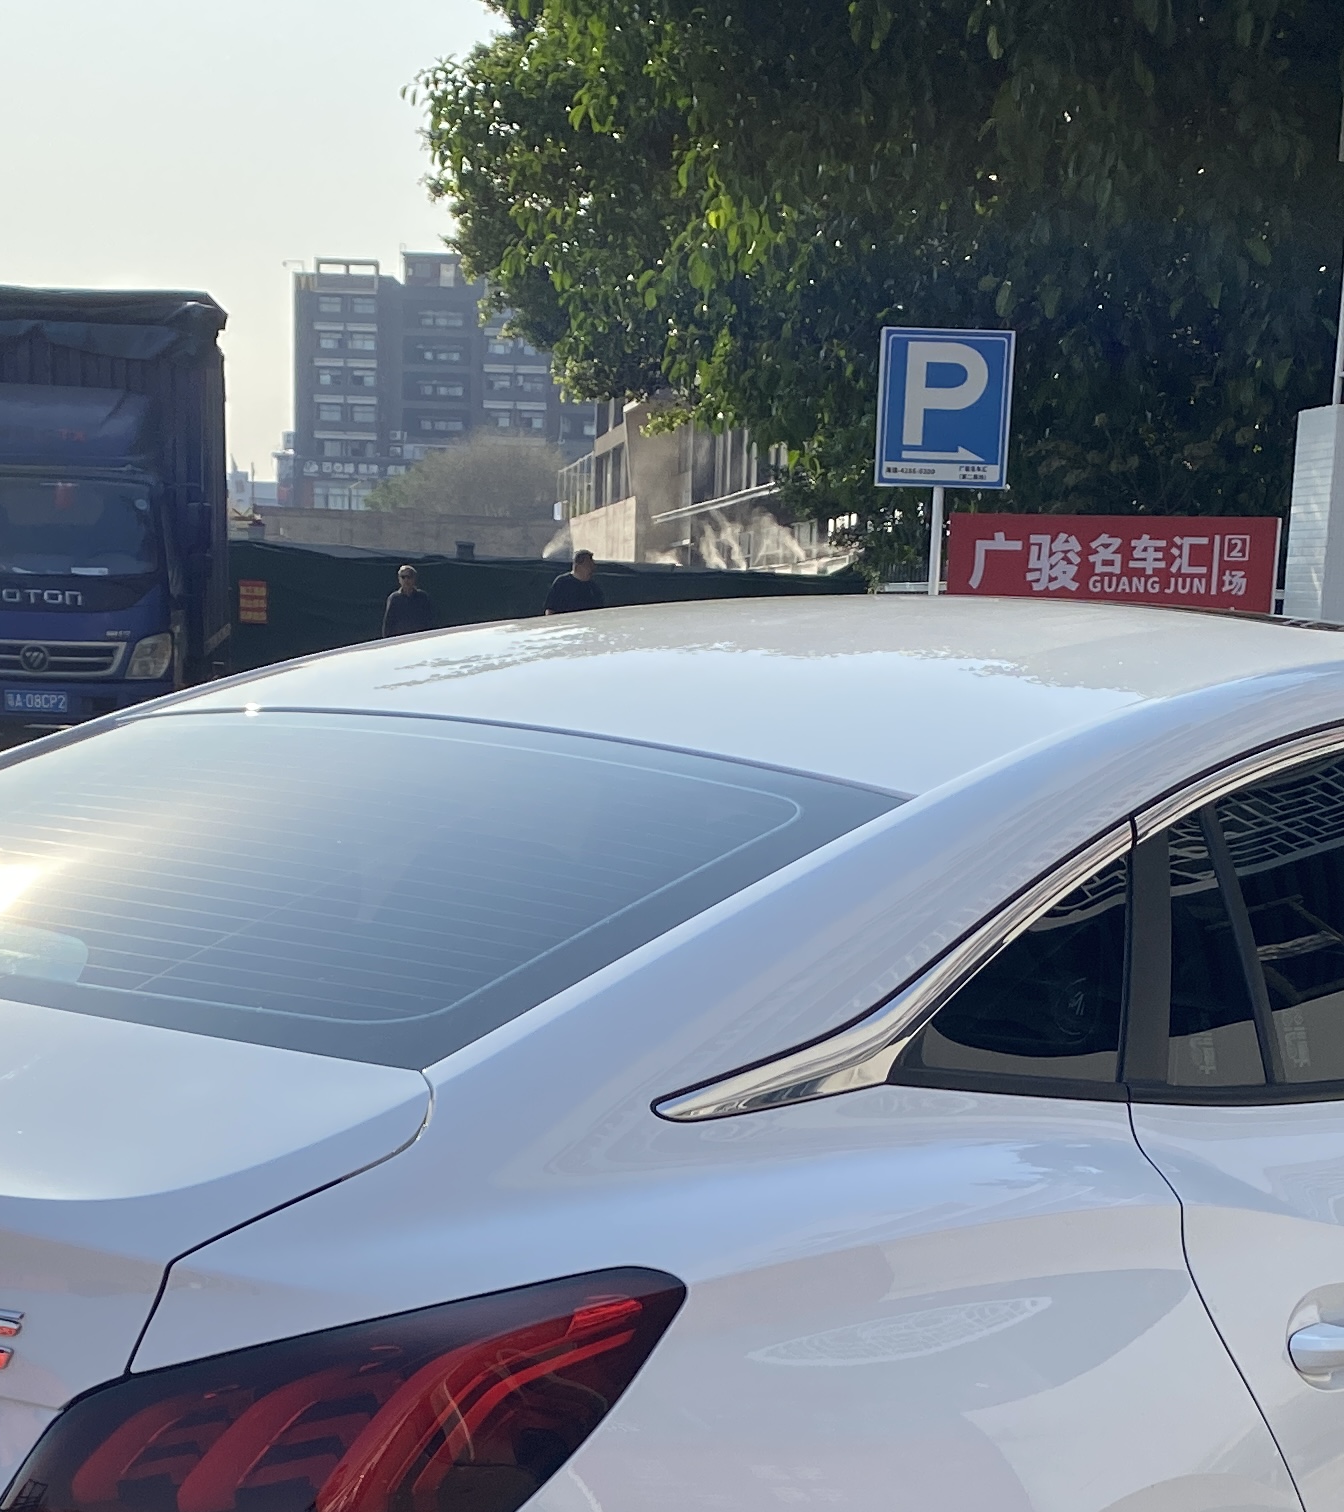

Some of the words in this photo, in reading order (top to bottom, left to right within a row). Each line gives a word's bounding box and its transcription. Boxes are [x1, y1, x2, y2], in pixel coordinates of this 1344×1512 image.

[902, 340, 989, 446] P
[968, 531, 1210, 592] 广骏名车汇
[1221, 570, 1247, 596] 场
[1088, 575, 1160, 593] GUANG
[1164, 577, 1206, 594] JUN
